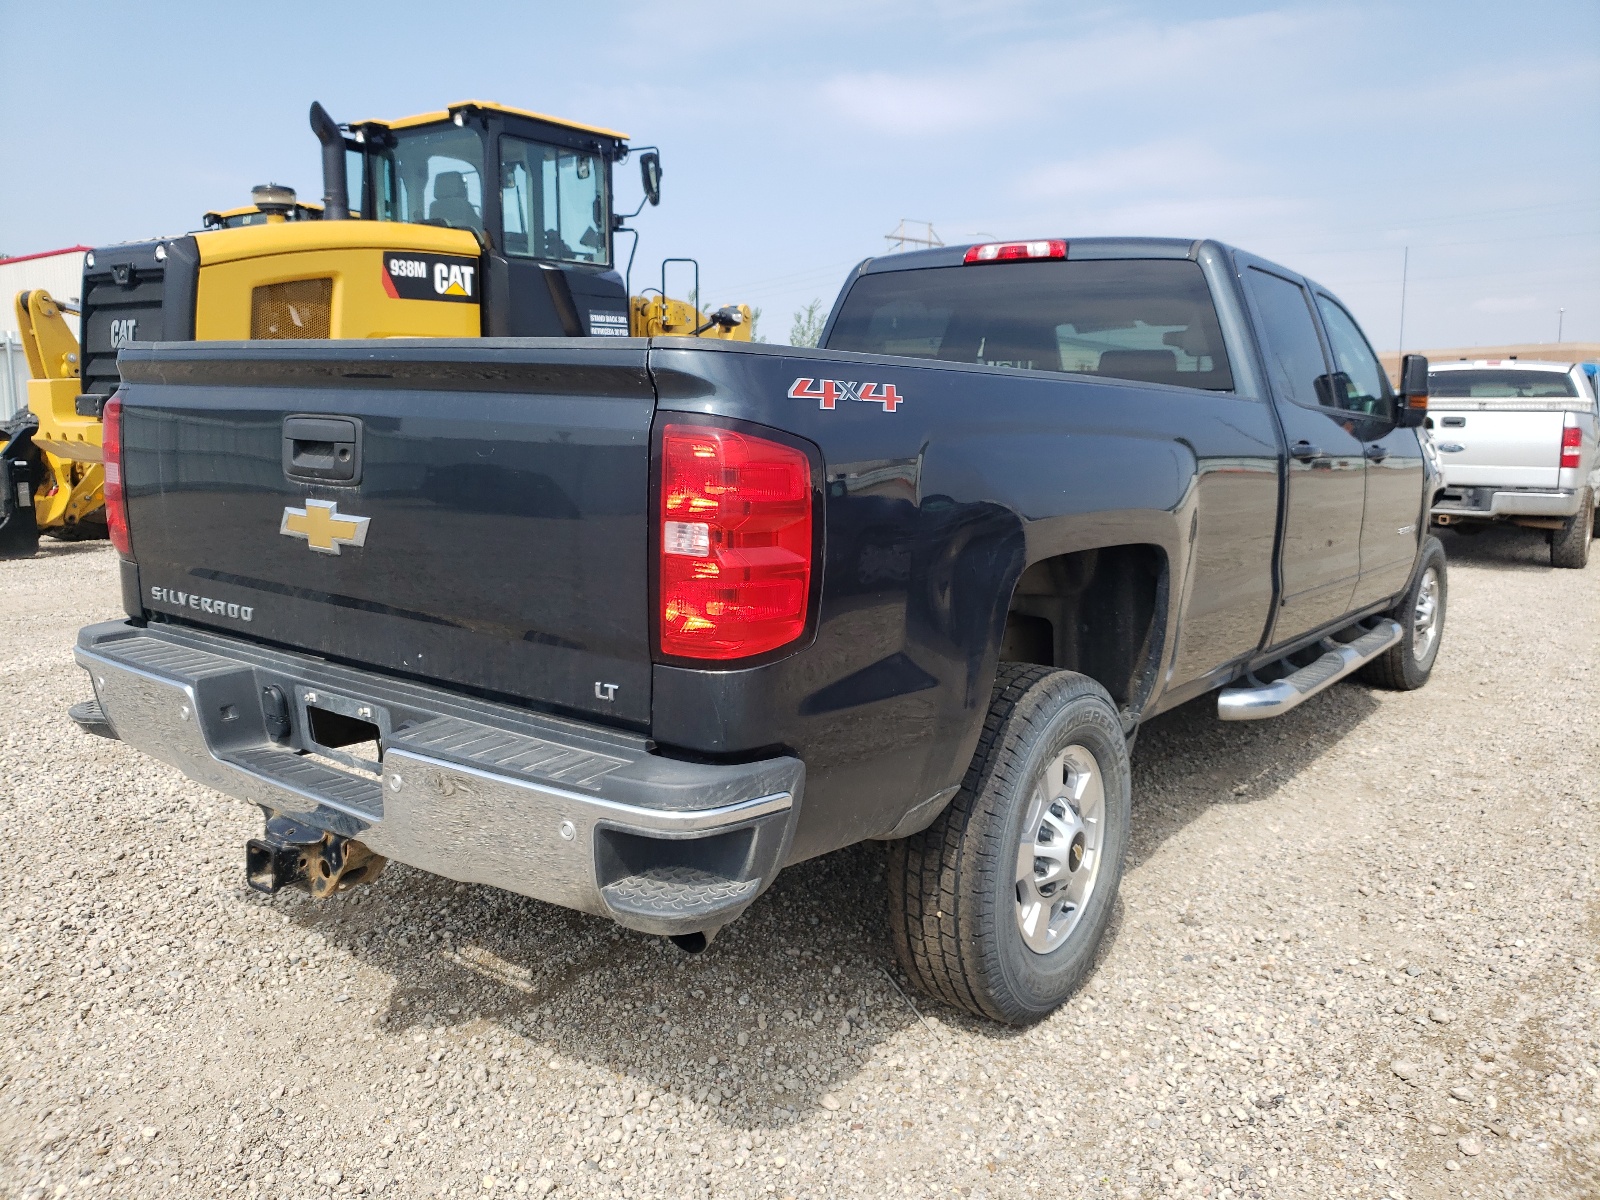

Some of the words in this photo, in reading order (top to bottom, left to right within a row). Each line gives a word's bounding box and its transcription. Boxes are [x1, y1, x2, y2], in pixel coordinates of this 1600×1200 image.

[389, 258, 427, 279] 938M
[433, 262, 475, 297] CAT
[110, 319, 136, 349] CAT
[151, 586, 254, 622] SILVERADO
[594, 681, 619, 702] LT
